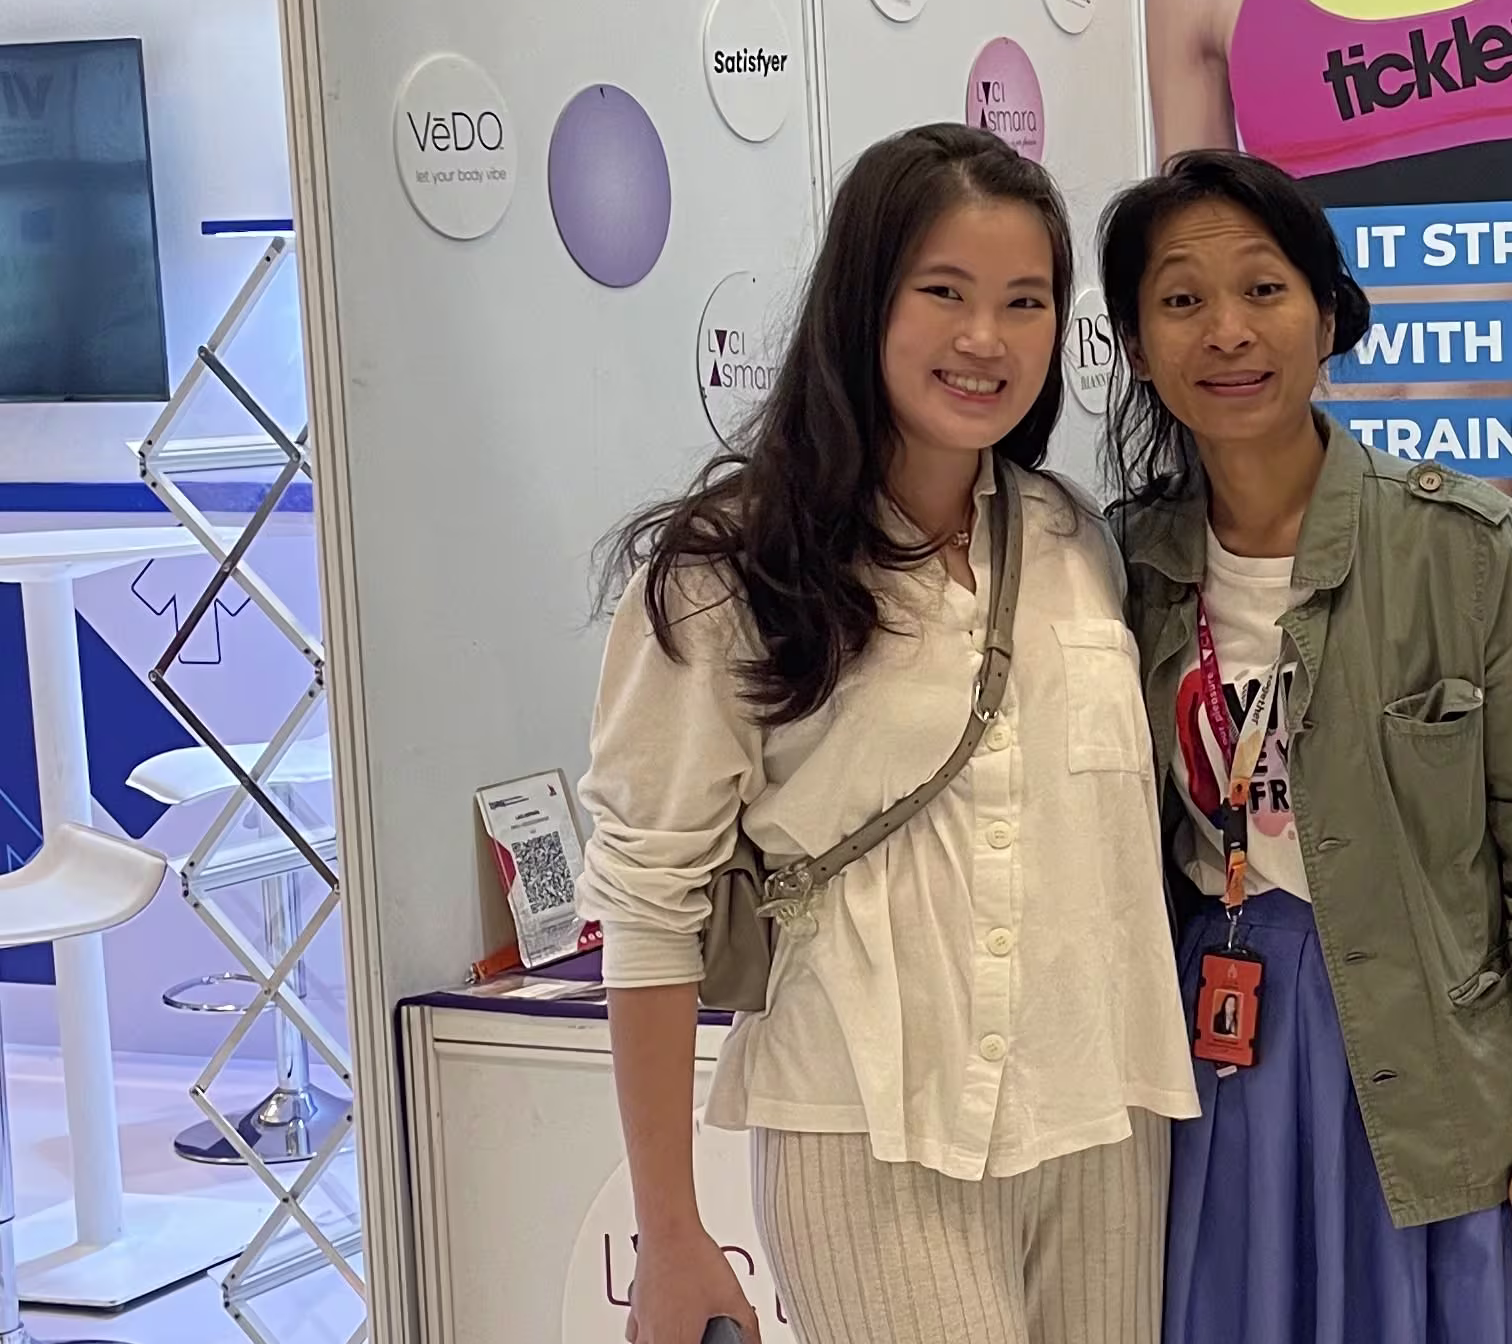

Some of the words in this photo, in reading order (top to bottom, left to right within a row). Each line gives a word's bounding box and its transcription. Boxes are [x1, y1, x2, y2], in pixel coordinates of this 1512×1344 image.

[714, 48, 788, 77] Satisfyer
[1356, 226, 1405, 269] IT
[1357, 320, 1503, 365] WITH
[710, 358, 778, 390] Asmar
